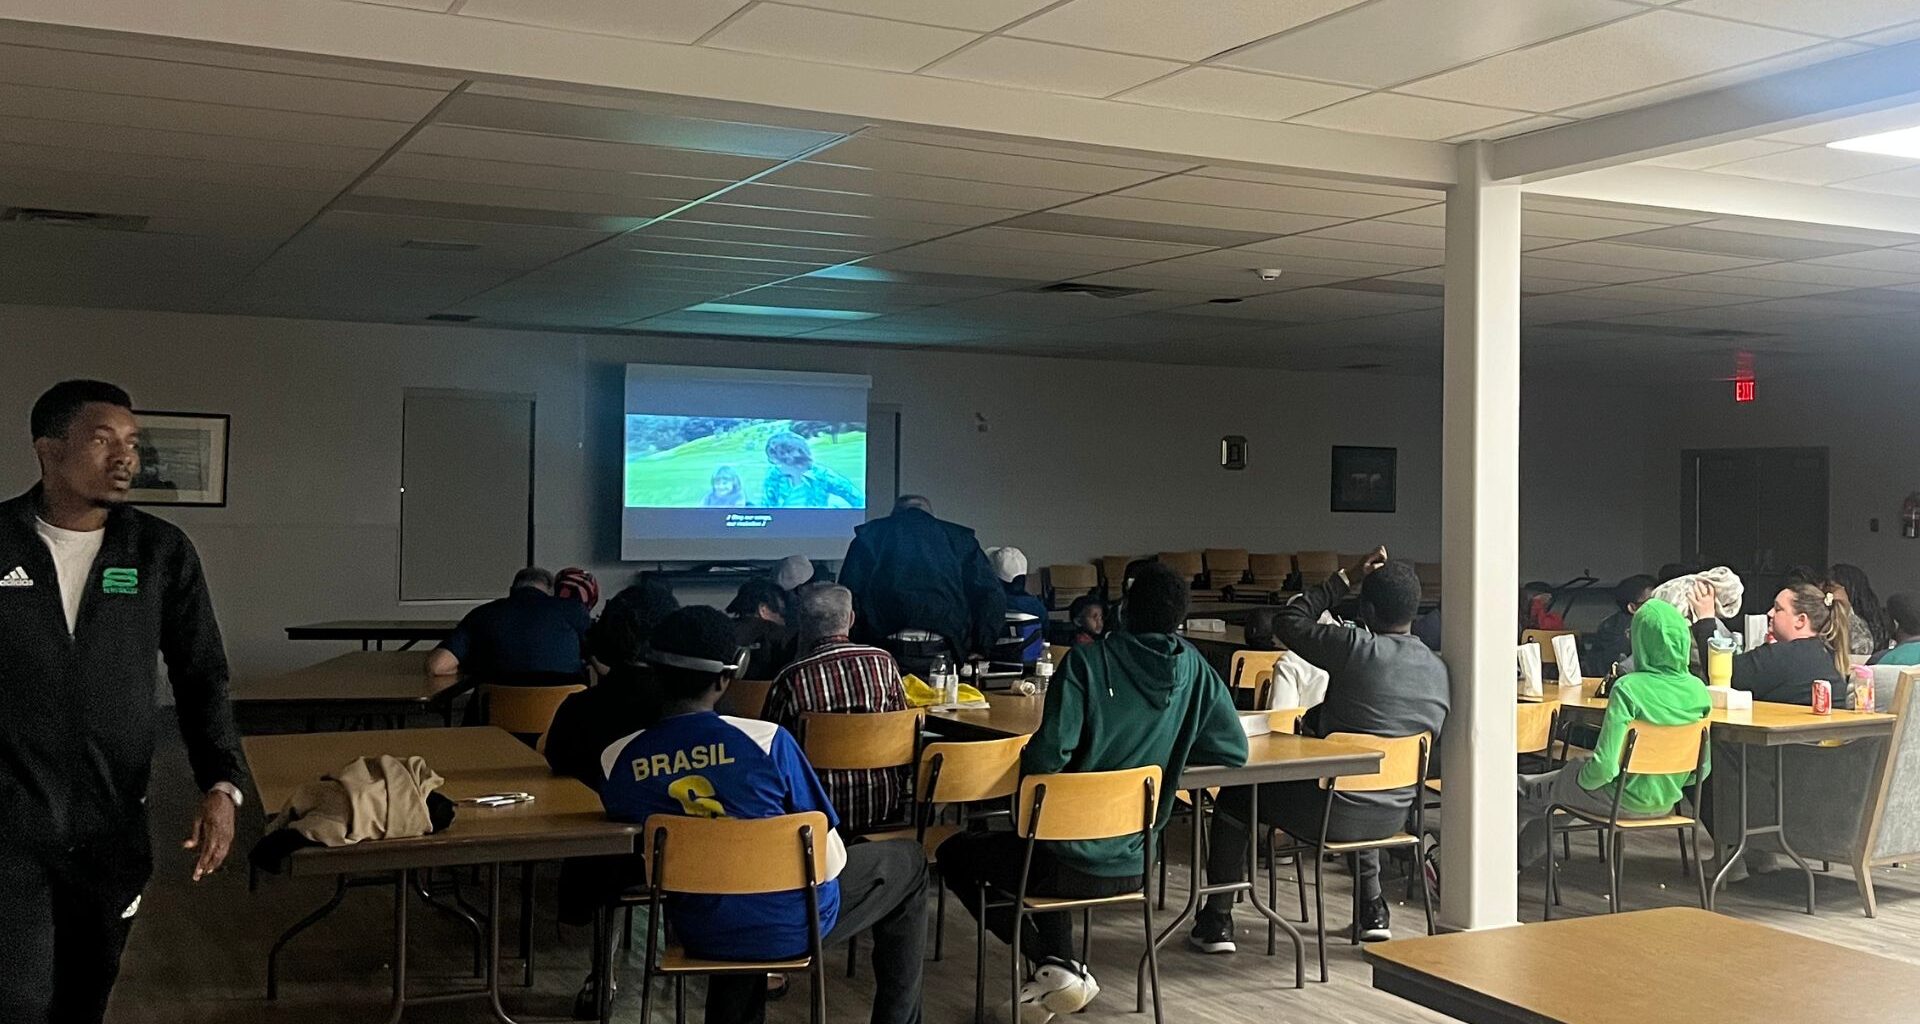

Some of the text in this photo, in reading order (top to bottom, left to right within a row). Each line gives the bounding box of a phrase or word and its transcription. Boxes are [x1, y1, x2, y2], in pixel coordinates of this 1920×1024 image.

[1736, 382, 1754, 401] EXIT
[0, 578, 34, 587] adidas
[632, 743, 735, 781] BRASIL
